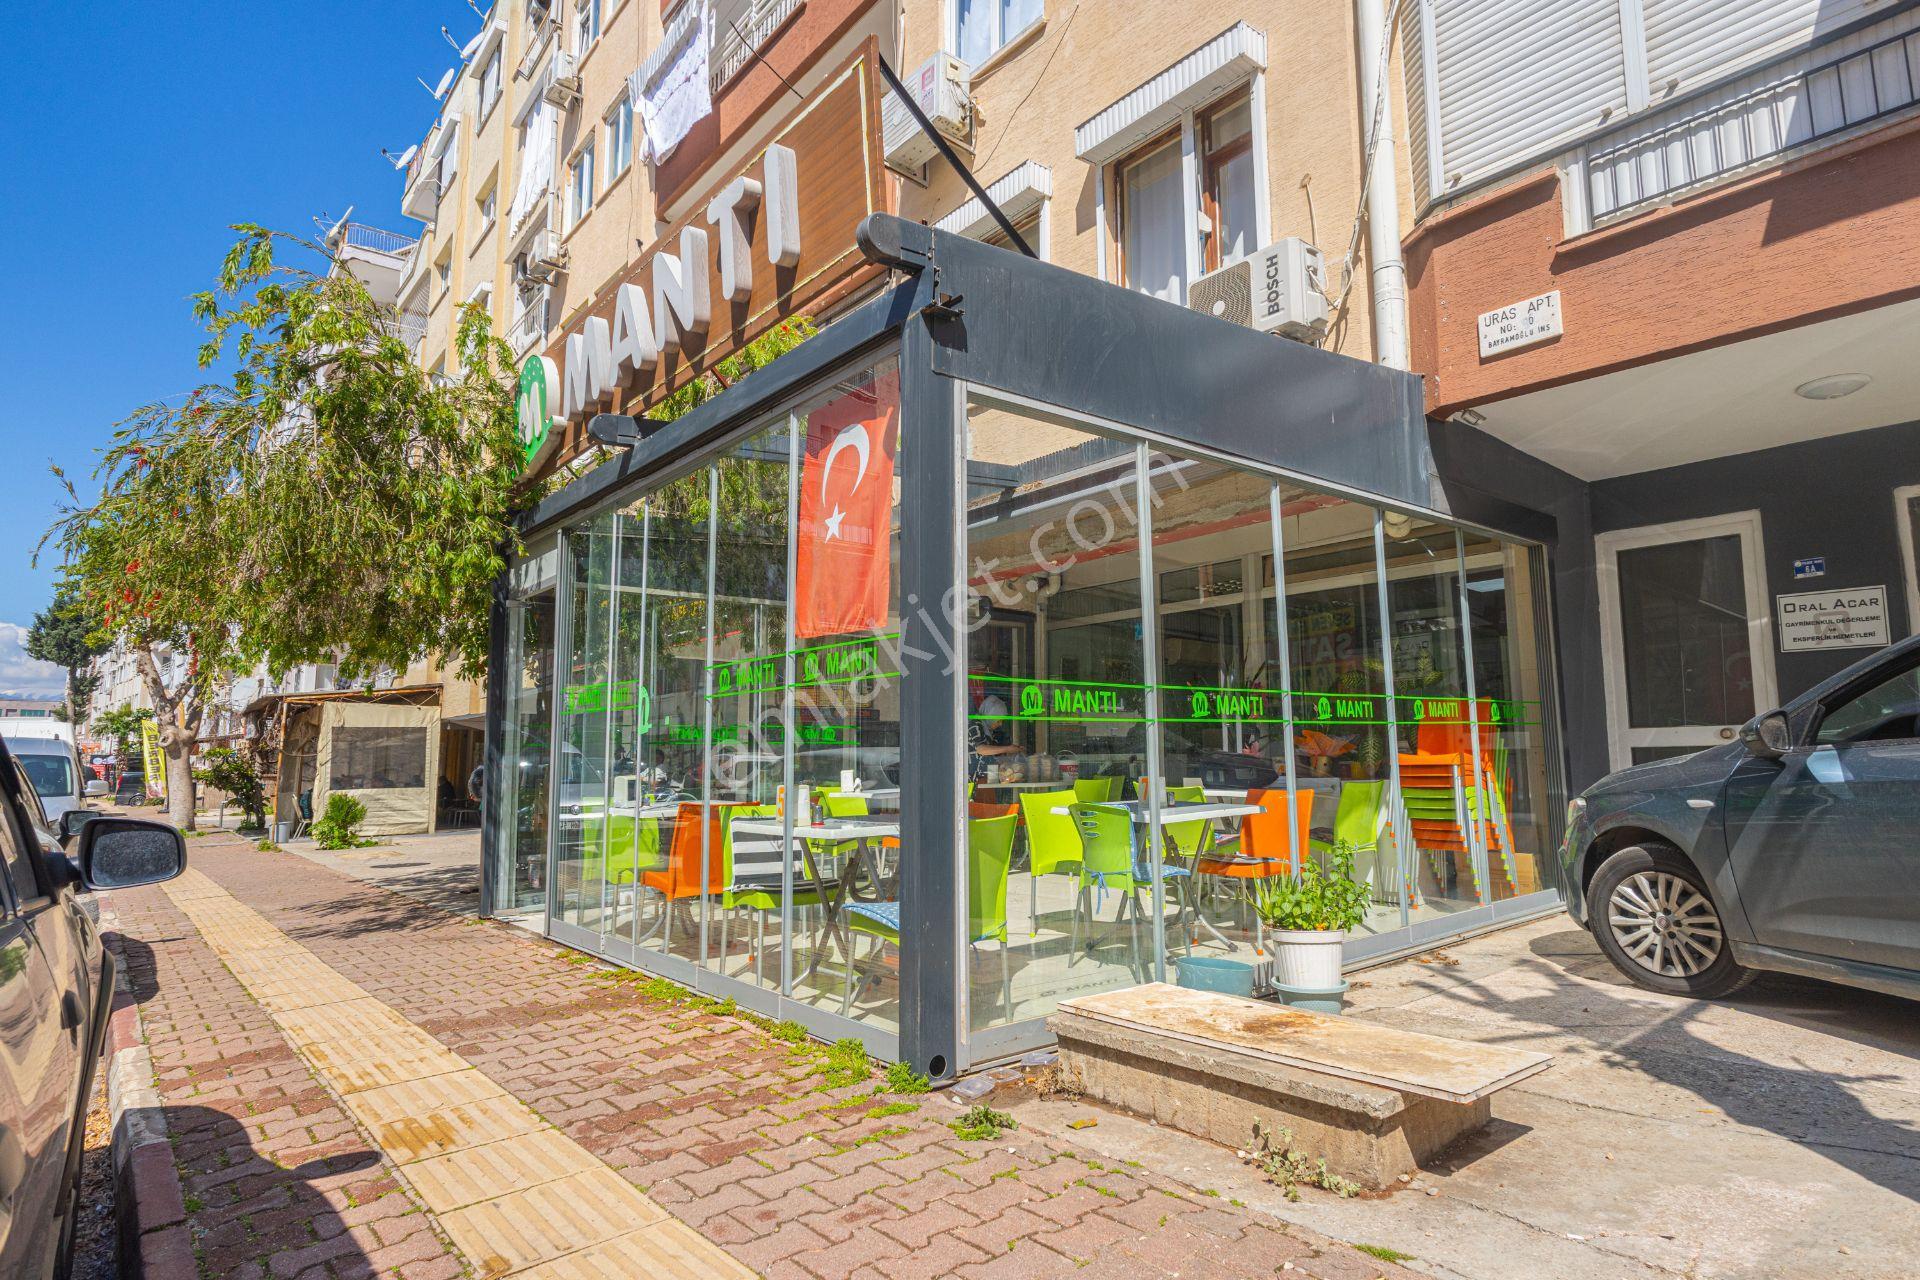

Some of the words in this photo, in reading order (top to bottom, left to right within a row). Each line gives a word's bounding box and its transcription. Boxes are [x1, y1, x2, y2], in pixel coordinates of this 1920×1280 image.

[562, 142, 799, 422] MANTI
[1266, 254, 1280, 316] BOSCH
[1484, 307, 1517, 328] URAS
[1527, 295, 1555, 314] APT.
[1500, 323, 1517, 335] NO:
[1783, 602, 1827, 613] ORAL
[1833, 597, 1880, 610] ACAR
[1836, 614, 1881, 624] DEĞERLEME
[826, 646, 878, 676] MANTI
[736, 663, 775, 687] MANTI
[1054, 688, 1117, 714] MANTI
[1216, 694, 1264, 716] MANTI
[1336, 699, 1374, 719] MANTI
[1428, 702, 1459, 718] MANTI
